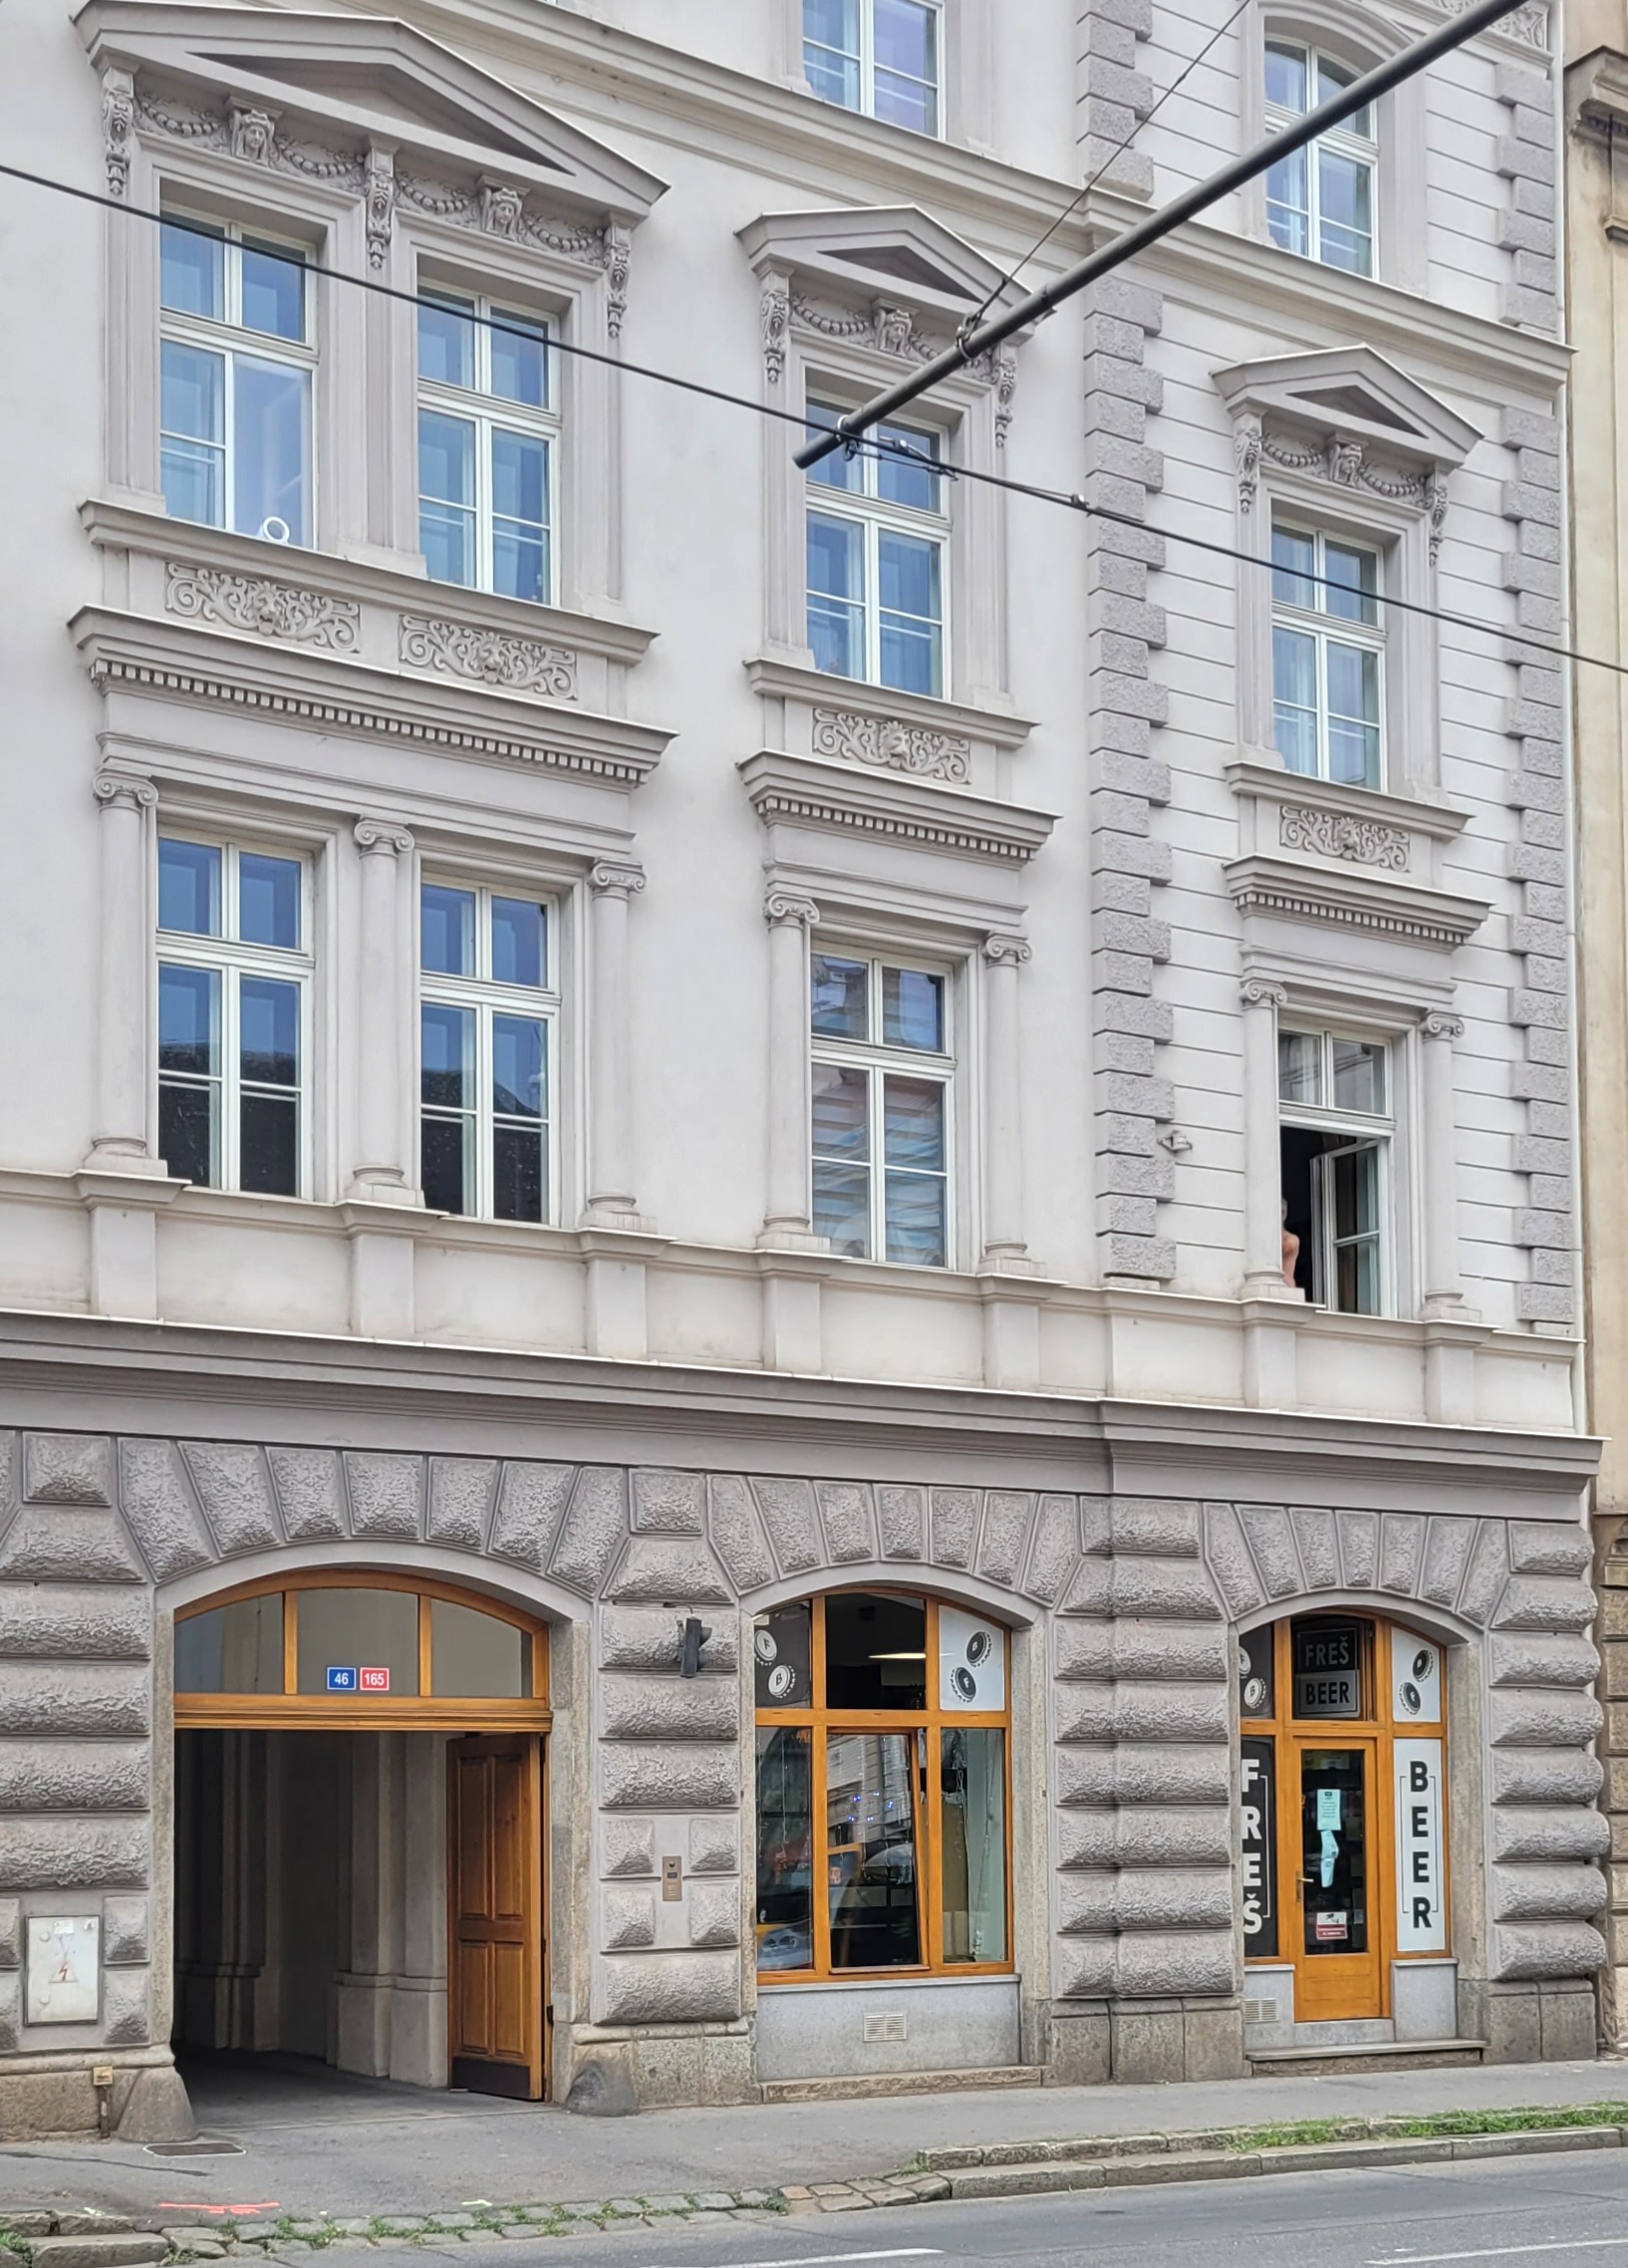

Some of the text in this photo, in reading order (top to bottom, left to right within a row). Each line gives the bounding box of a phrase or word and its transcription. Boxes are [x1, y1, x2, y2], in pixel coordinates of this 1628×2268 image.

[1305, 1636, 1349, 1666] FREŠ
[334, 1672, 349, 1685] 46
[364, 1673, 385, 1686] 165
[1305, 1681, 1350, 1705] BEER
[1241, 1759, 1262, 1934] FREŠ
[1410, 1761, 1432, 1928] BEER
